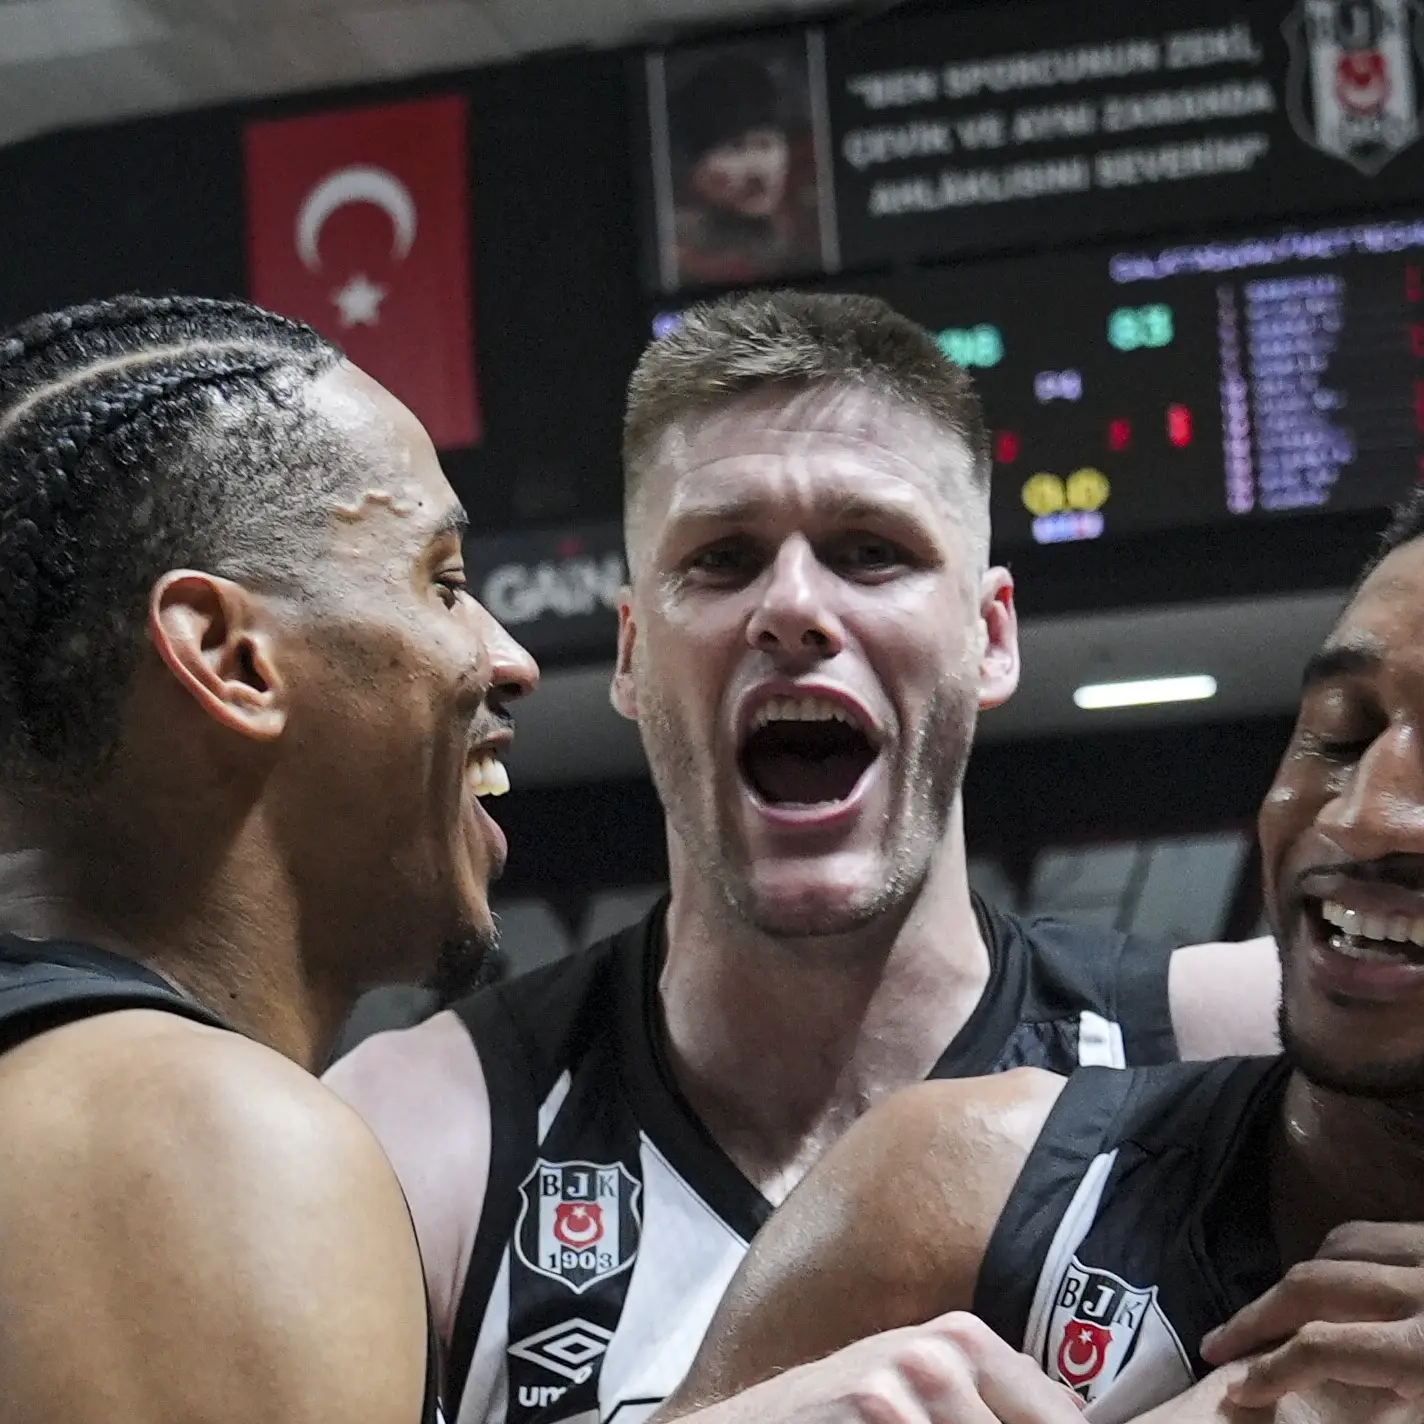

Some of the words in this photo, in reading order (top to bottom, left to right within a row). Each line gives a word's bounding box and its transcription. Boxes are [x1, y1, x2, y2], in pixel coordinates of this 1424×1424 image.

[541, 1171, 618, 1198] BJK
[547, 1250, 614, 1270] 1903
[1059, 1277, 1144, 1330] BJK
